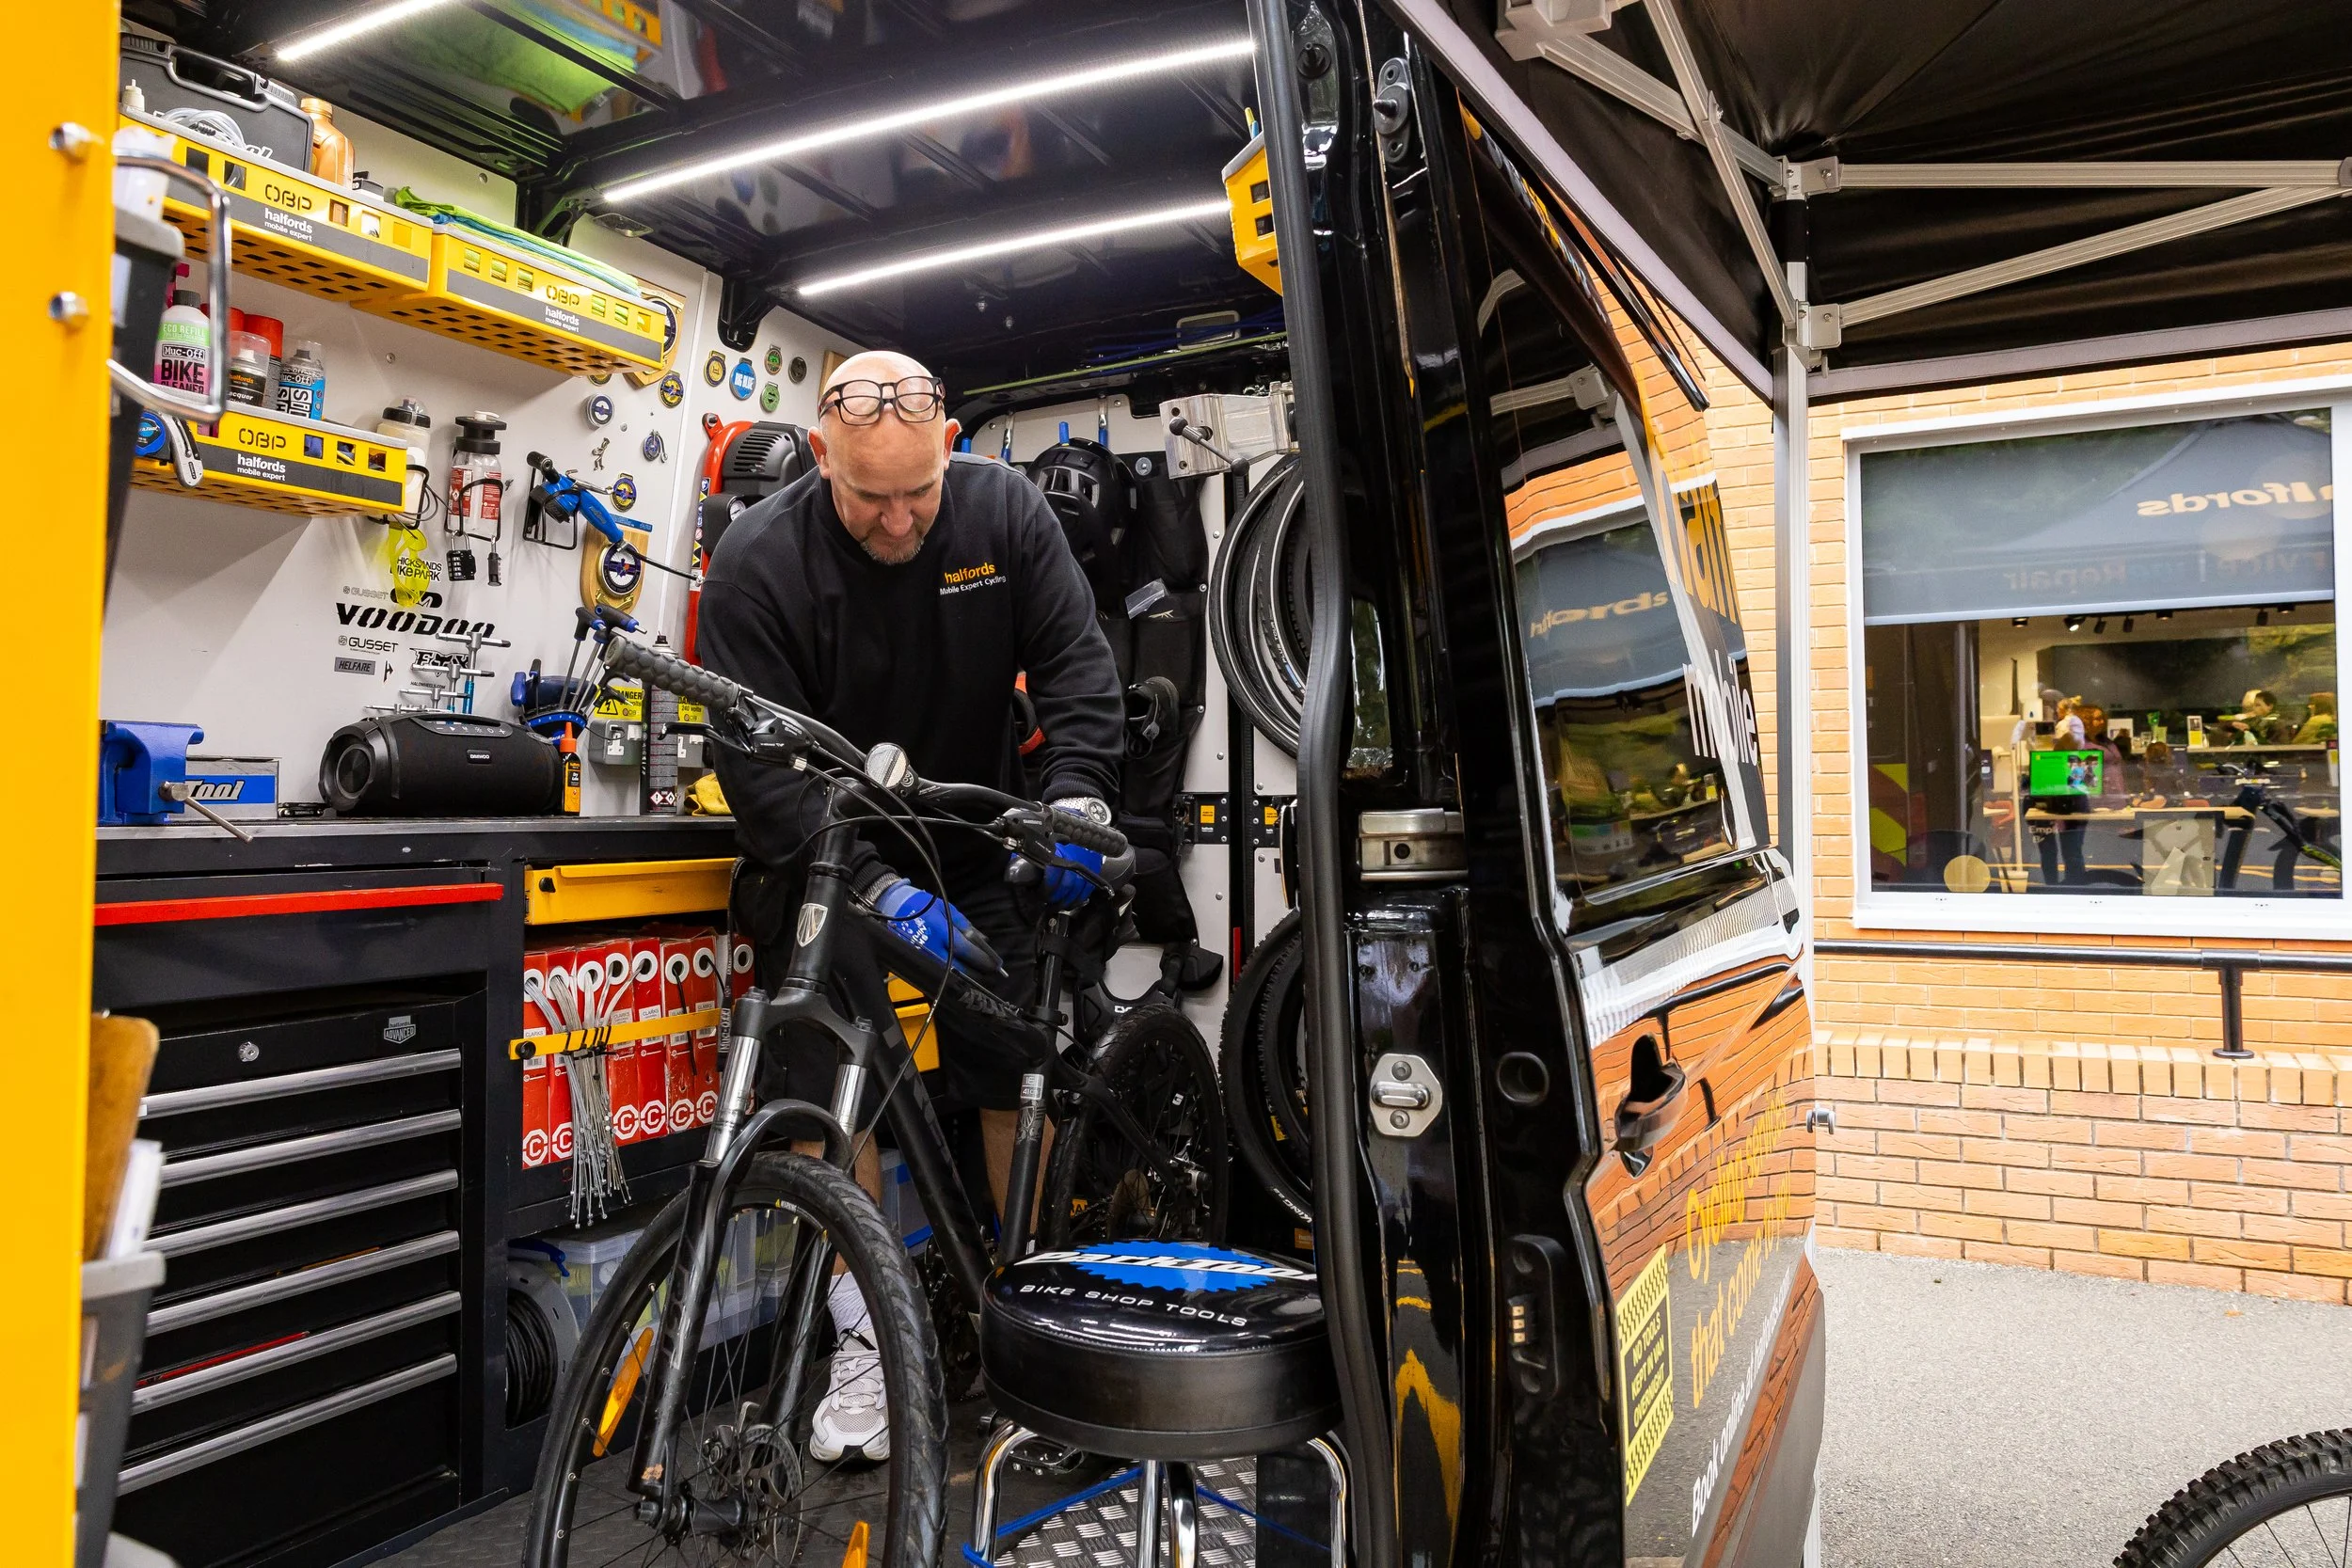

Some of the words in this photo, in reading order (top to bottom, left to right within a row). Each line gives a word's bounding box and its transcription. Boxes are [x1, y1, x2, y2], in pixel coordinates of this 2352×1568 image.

[265, 184, 311, 211] OBP
[264, 208, 313, 234] halfords
[264, 221, 288, 235] mobile
[289, 230, 312, 242] expert
[546, 285, 580, 306] OBP
[545, 317, 563, 327] mobile
[563, 322, 580, 332] expert
[546, 306, 580, 325] halfords
[164, 324, 178, 333] ECO
[180, 325, 204, 338] REFILL
[165, 346, 204, 359] Muc-Off
[161, 358, 205, 386] BIKE
[282, 374, 311, 387] uc-Off
[229, 391, 254, 402] acquer
[239, 428, 286, 450] OBP
[237, 453, 286, 473] halfords
[237, 467, 262, 477] mobile
[262, 471, 285, 482] expert
[945, 562, 996, 583] halfords
[351, 587, 389, 600] GUSSET
[940, 585, 960, 595] Mobile
[960, 580, 983, 592] Expert
[984, 575, 1007, 586] Cycling
[336, 602, 495, 639] VOODOO
[349, 637, 399, 653] GUSSET
[339, 659, 373, 673] HELFARE
[616, 690, 644, 701] ANGER
[1682, 648, 1757, 766] mobile
[643, 1008, 659, 1017] CLARKS
[386, 1026, 414, 1041] ADVANCED
[1687, 1148, 1745, 1284] Cycling
[1746, 1086, 1787, 1189] services
[1691, 1281, 1724, 1408] that
[1728, 1227, 1762, 1336] come
[1764, 1200, 1774, 1260] to
[1775, 1170, 1790, 1252] you
[1019, 1284, 1074, 1296] BIKE
[1085, 1291, 1153, 1307] SHOP
[1166, 1303, 1248, 1326] TOOLS
[1632, 1340, 1643, 1367] NO
[1643, 1311, 1661, 1353] TOOLS
[1631, 1362, 1647, 1401] KEPT
[1647, 1351, 1654, 1376] IN
[1654, 1335, 1664, 1364] VAN
[1633, 1362, 1664, 1428] OVERNIGHT
[1692, 1438, 1719, 1538] Book
[1720, 1388, 1746, 1465] online
[1746, 1358, 1754, 1402] at
